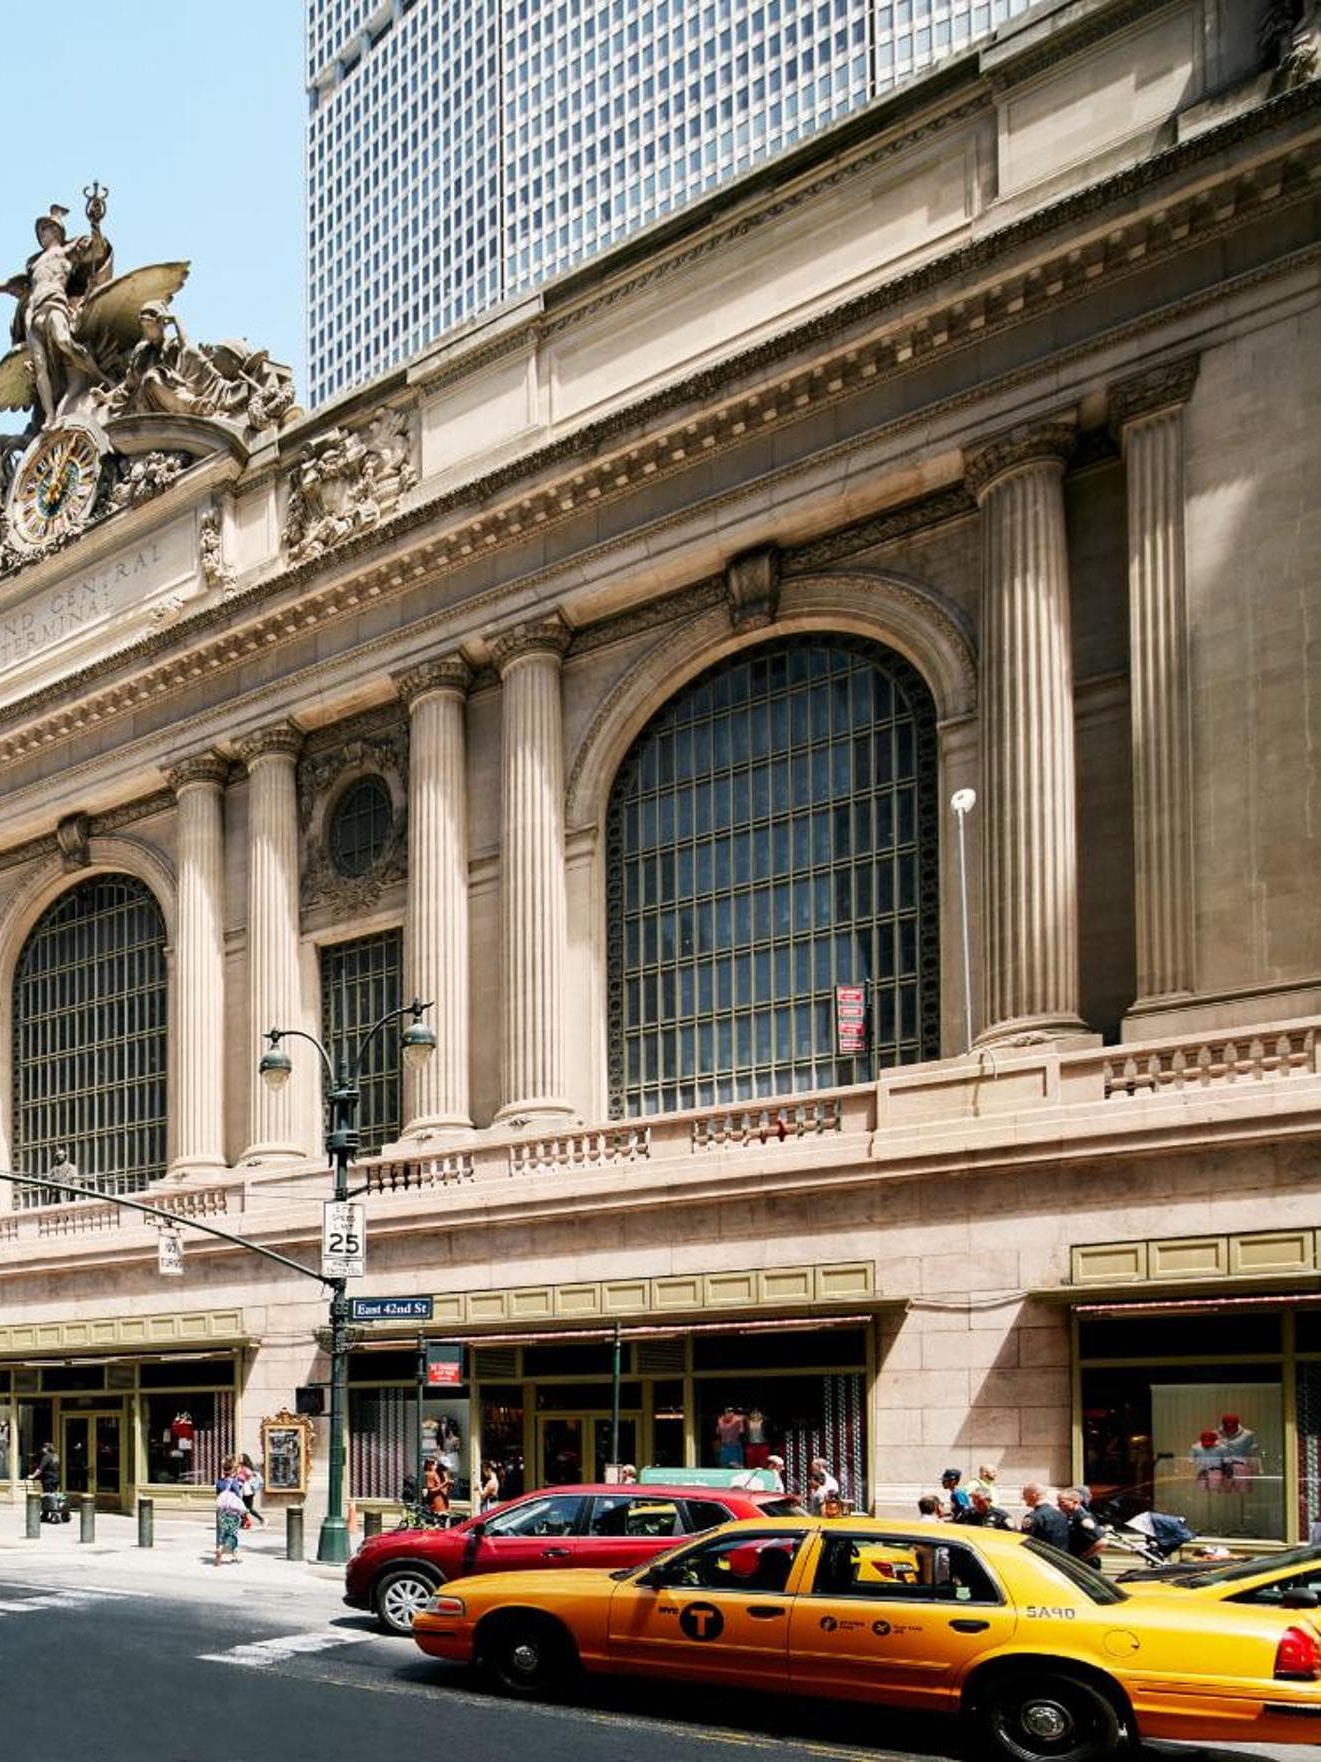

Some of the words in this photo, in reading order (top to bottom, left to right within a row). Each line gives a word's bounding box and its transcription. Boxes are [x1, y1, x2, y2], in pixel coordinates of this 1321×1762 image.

[49, 545, 160, 613] CENTRAL
[2, 594, 116, 662] TERMINAL
[329, 1233, 359, 1254] 25
[358, 1304, 381, 1315] East
[383, 1302, 411, 1314] 42nd
[414, 1302, 427, 1313] St
[690, 1609, 714, 1636] T
